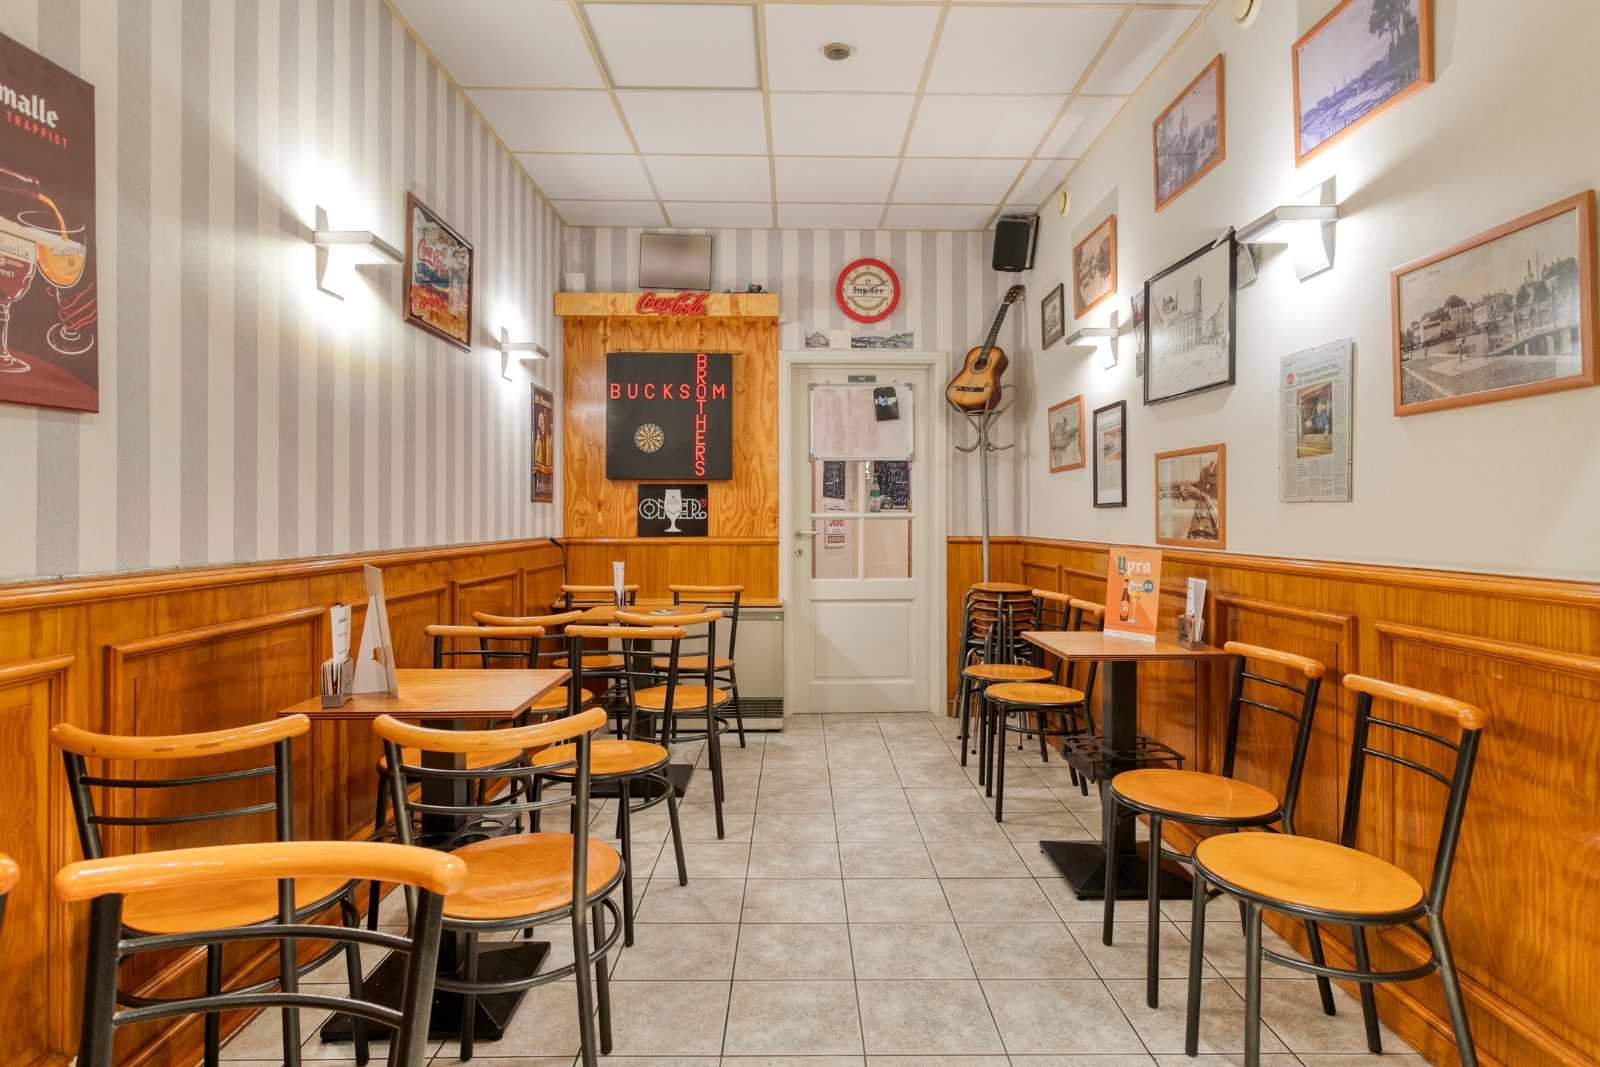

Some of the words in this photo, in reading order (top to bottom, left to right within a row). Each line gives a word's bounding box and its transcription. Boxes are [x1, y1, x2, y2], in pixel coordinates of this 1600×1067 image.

[7, 110, 68, 149] TRAPPIST
[636, 291, 710, 317] Coca-Cola
[609, 382, 726, 400] BUCKSOM
[694, 353, 708, 477] BROTHERS
[1117, 556, 1151, 576] Ypra
